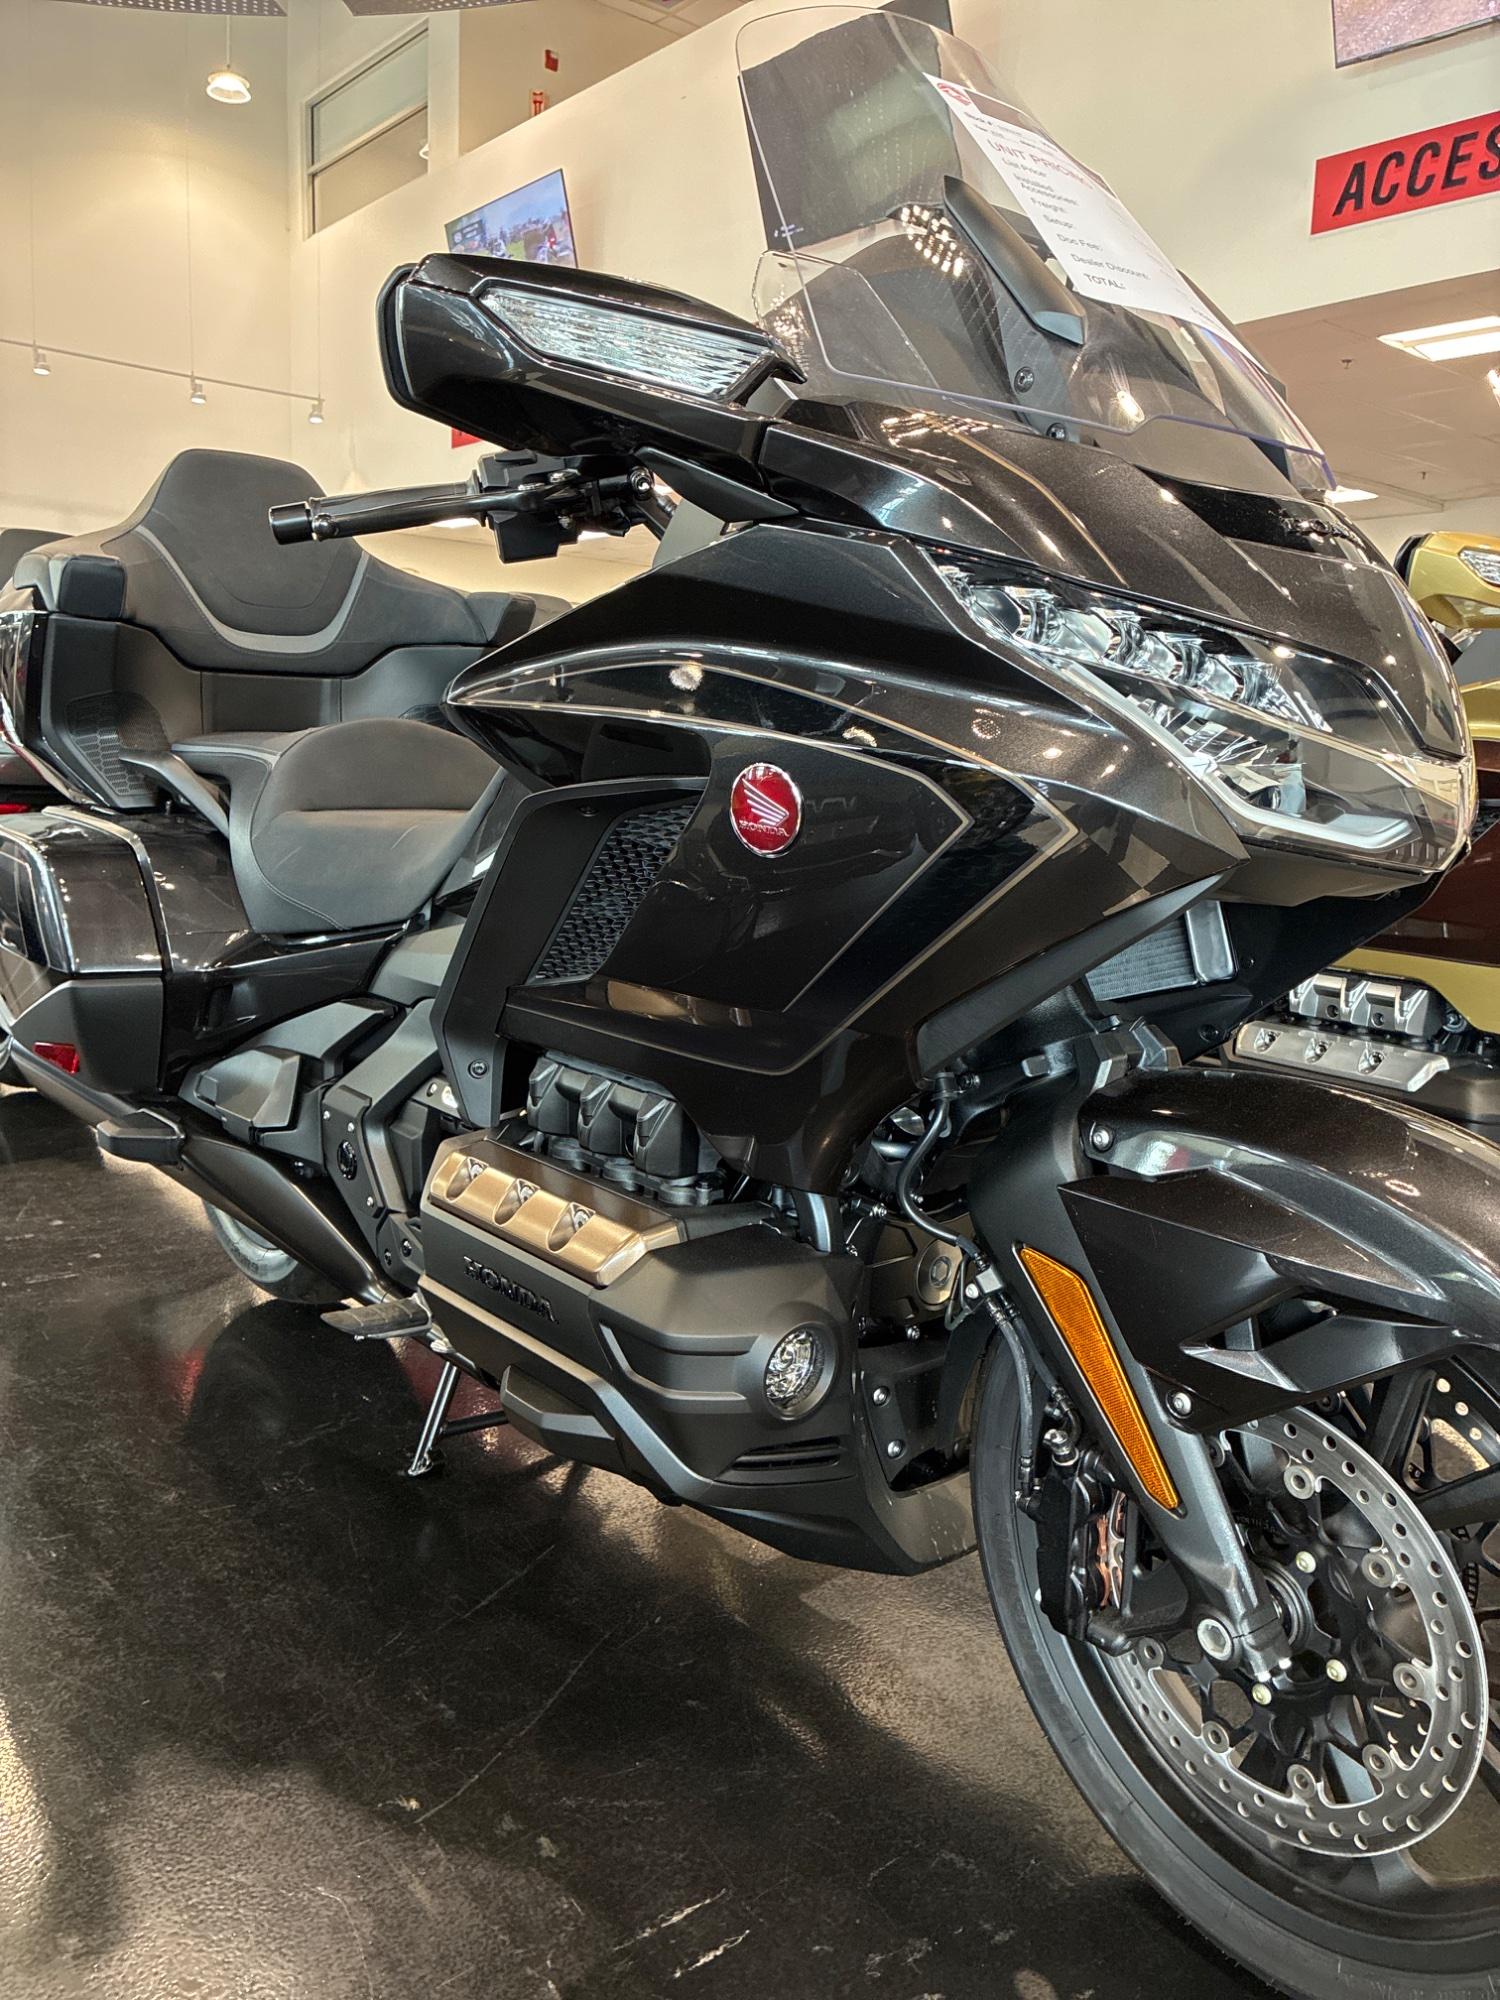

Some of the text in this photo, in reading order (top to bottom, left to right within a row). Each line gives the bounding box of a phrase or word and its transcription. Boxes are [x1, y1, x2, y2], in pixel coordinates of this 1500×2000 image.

[986, 138, 1026, 161] UNIT
[1332, 124, 1500, 217] ACCES
[1070, 253, 1105, 268] Dealer
[1082, 272, 1127, 290] TOTAL:
[739, 819, 791, 837] HONDA
[463, 1255, 558, 1322] HONDA
